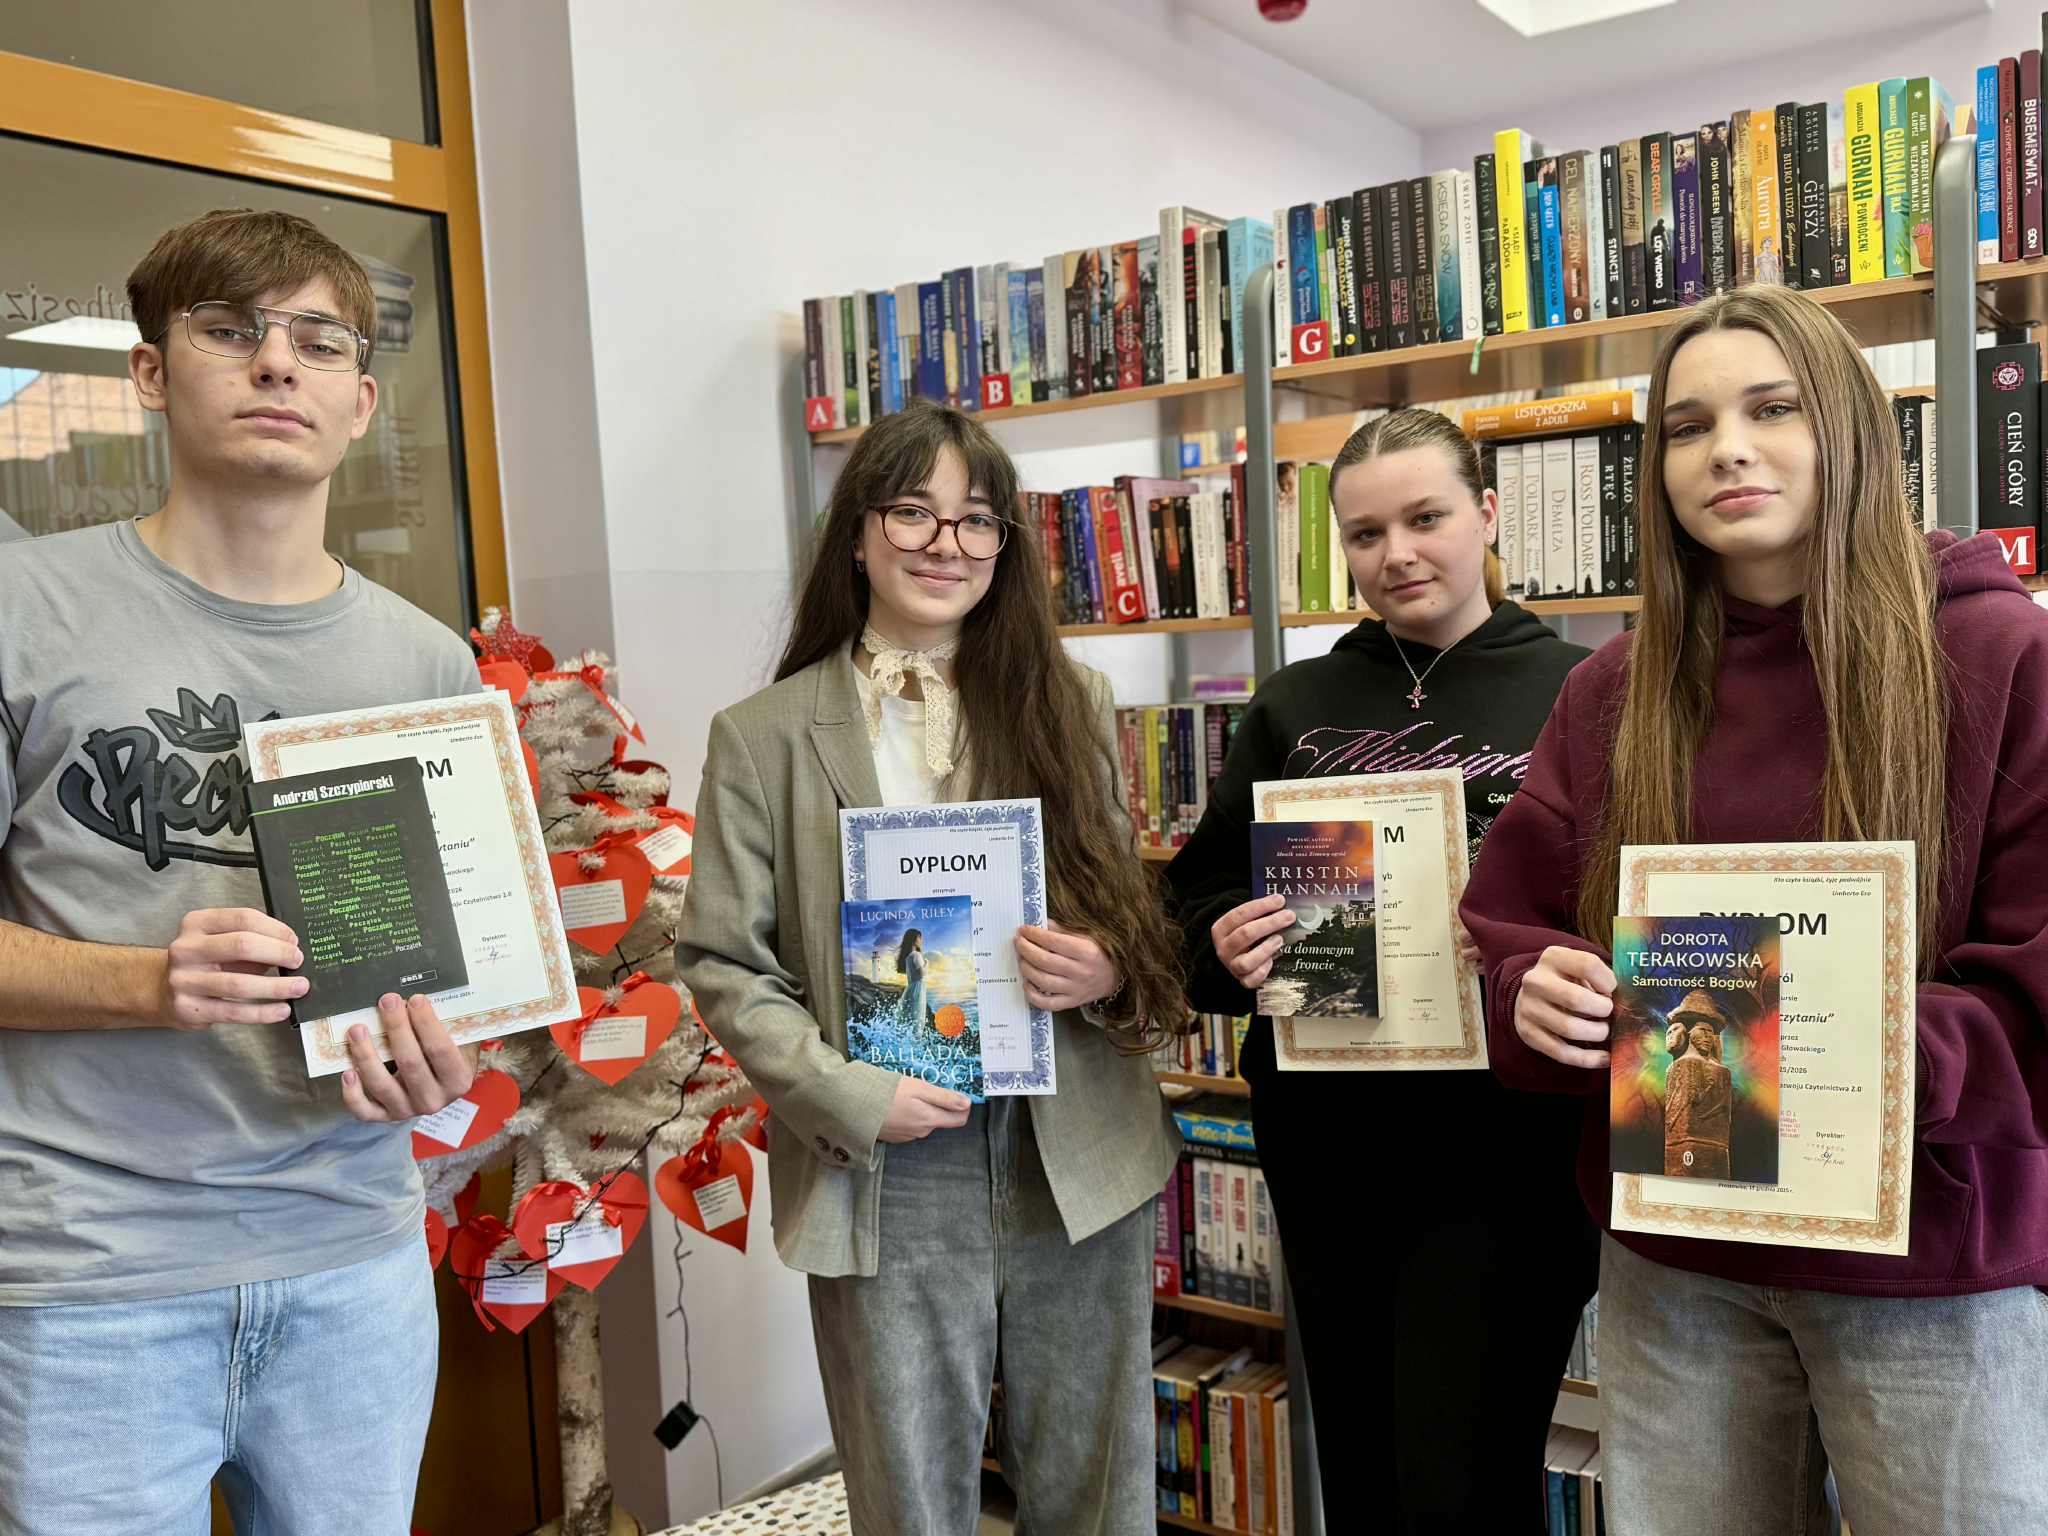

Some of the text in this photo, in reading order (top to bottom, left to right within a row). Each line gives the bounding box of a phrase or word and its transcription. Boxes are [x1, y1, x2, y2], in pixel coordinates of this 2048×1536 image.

[1804, 111, 1812, 153] GOLDEN
[1811, 110, 1819, 152] ARTHUR
[2024, 98, 2038, 144] BUSEM
[1650, 141, 1661, 174] BEAR
[1883, 127, 1906, 196] GURNAH
[1979, 138, 1994, 157] TRZY
[1709, 156, 1719, 181] JOHN
[1783, 153, 1794, 185] BIURO
[1850, 134, 1872, 202] GURNAH
[1565, 158, 1582, 264] CEL NAMIERZONY
[1711, 184, 1721, 215] GREEN
[1756, 175, 1774, 231] Aurora
[1785, 187, 1795, 218] LUDZI
[1802, 180, 1819, 239] GEJSZY
[1856, 203, 1869, 253] POWRÓCENI
[1341, 216, 1357, 325] JOHN GALSWORTHY
[1607, 238, 1619, 283] STANCJE
[1653, 235, 1664, 289] LOT WIDMO
[1299, 326, 1323, 355] G
[987, 380, 1004, 404] B
[811, 403, 828, 426] A
[1514, 399, 1588, 420] LISTONOSZKA
[1535, 417, 1541, 427] Z
[2007, 411, 2026, 507] CIEŃ GÓRY
[1602, 464, 1616, 501] RTĘĆ
[1622, 456, 1633, 503] ŻELAZO
[1502, 475, 1518, 544] POLDARK
[1525, 474, 1539, 542] POLDARK
[1550, 489, 1567, 553] DEMELZA
[1579, 463, 1596, 573] ROSS POLDARK
[1999, 535, 2031, 566] M
[1110, 551, 1127, 588] avell
[1117, 591, 1137, 616] C
[273, 774, 395, 807] Andrzej Szczypiorski
[439, 838, 475, 852] ytaniu”
[899, 853, 987, 874] DYPLOM
[1264, 866, 1359, 880] KRISTIN
[1265, 882, 1361, 896] HANNAH
[860, 906, 955, 923] LUCINDA RILEY
[1294, 942, 1354, 957] domowym
[1660, 932, 1728, 947] DOROTA
[1292, 957, 1336, 973] froncie
[1627, 951, 1764, 969] TERAKOWSKA
[1632, 974, 1758, 991] Samotność Bogów
[871, 1045, 967, 1063] BALLADA
[1781, 1044, 1826, 1054] Głowackiego
[895, 1061, 975, 1084] ŁOŚCI
[1779, 1066, 1808, 1075] 25/2026
[1804, 1083, 1850, 1092] Czytelnictwa
[1154, 1265, 1171, 1288] F
